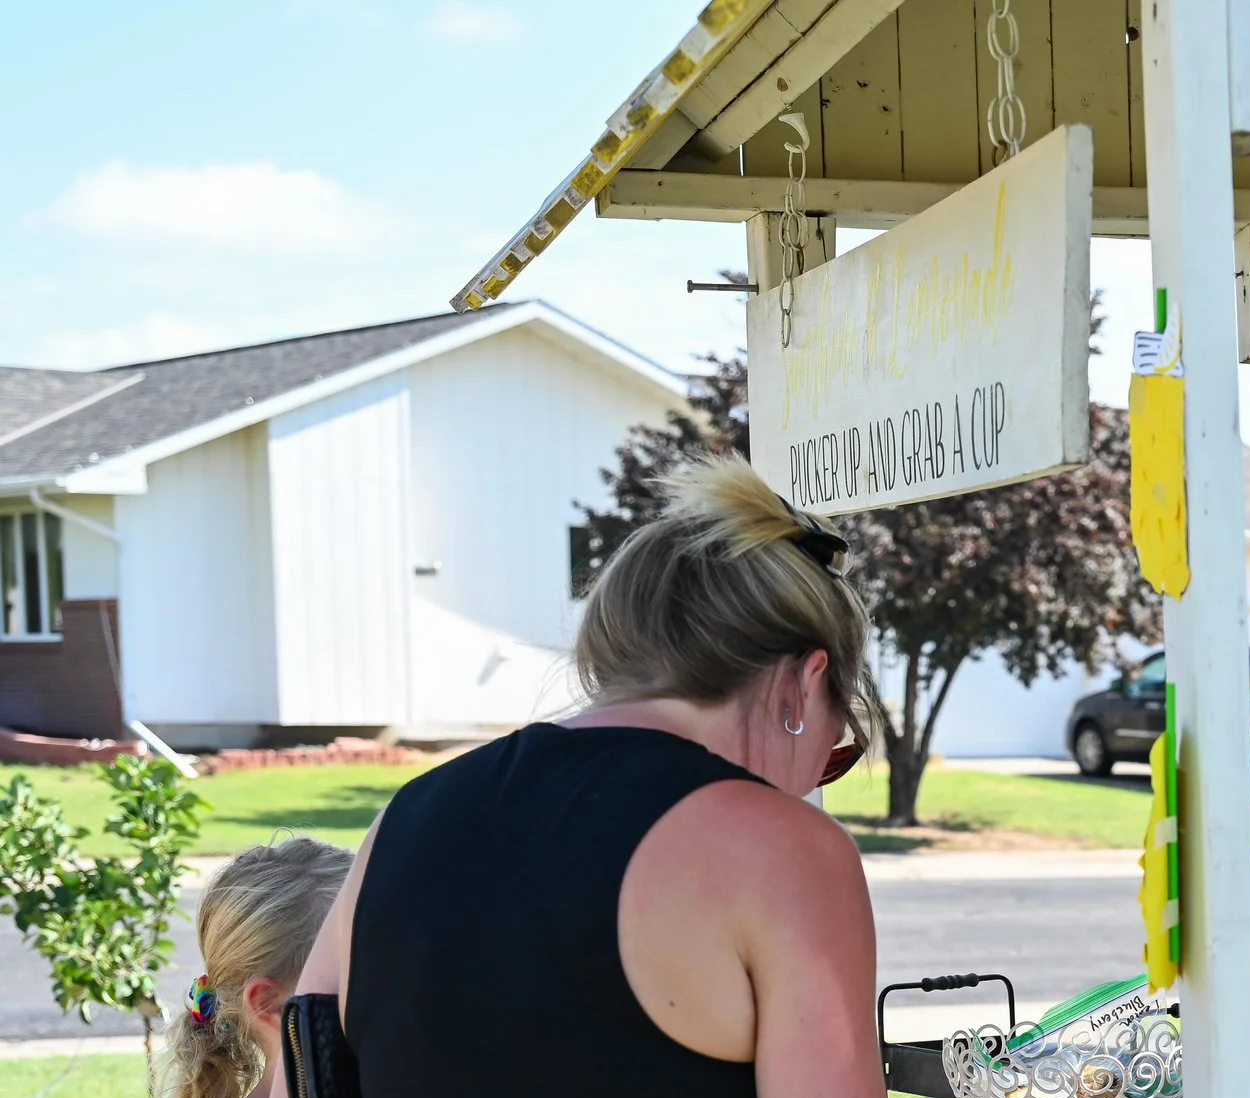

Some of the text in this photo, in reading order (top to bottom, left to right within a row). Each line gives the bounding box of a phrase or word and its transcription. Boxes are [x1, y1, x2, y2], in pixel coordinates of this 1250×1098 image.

[790, 381, 1005, 506] PUCKER UP AND GRAB A CUP
